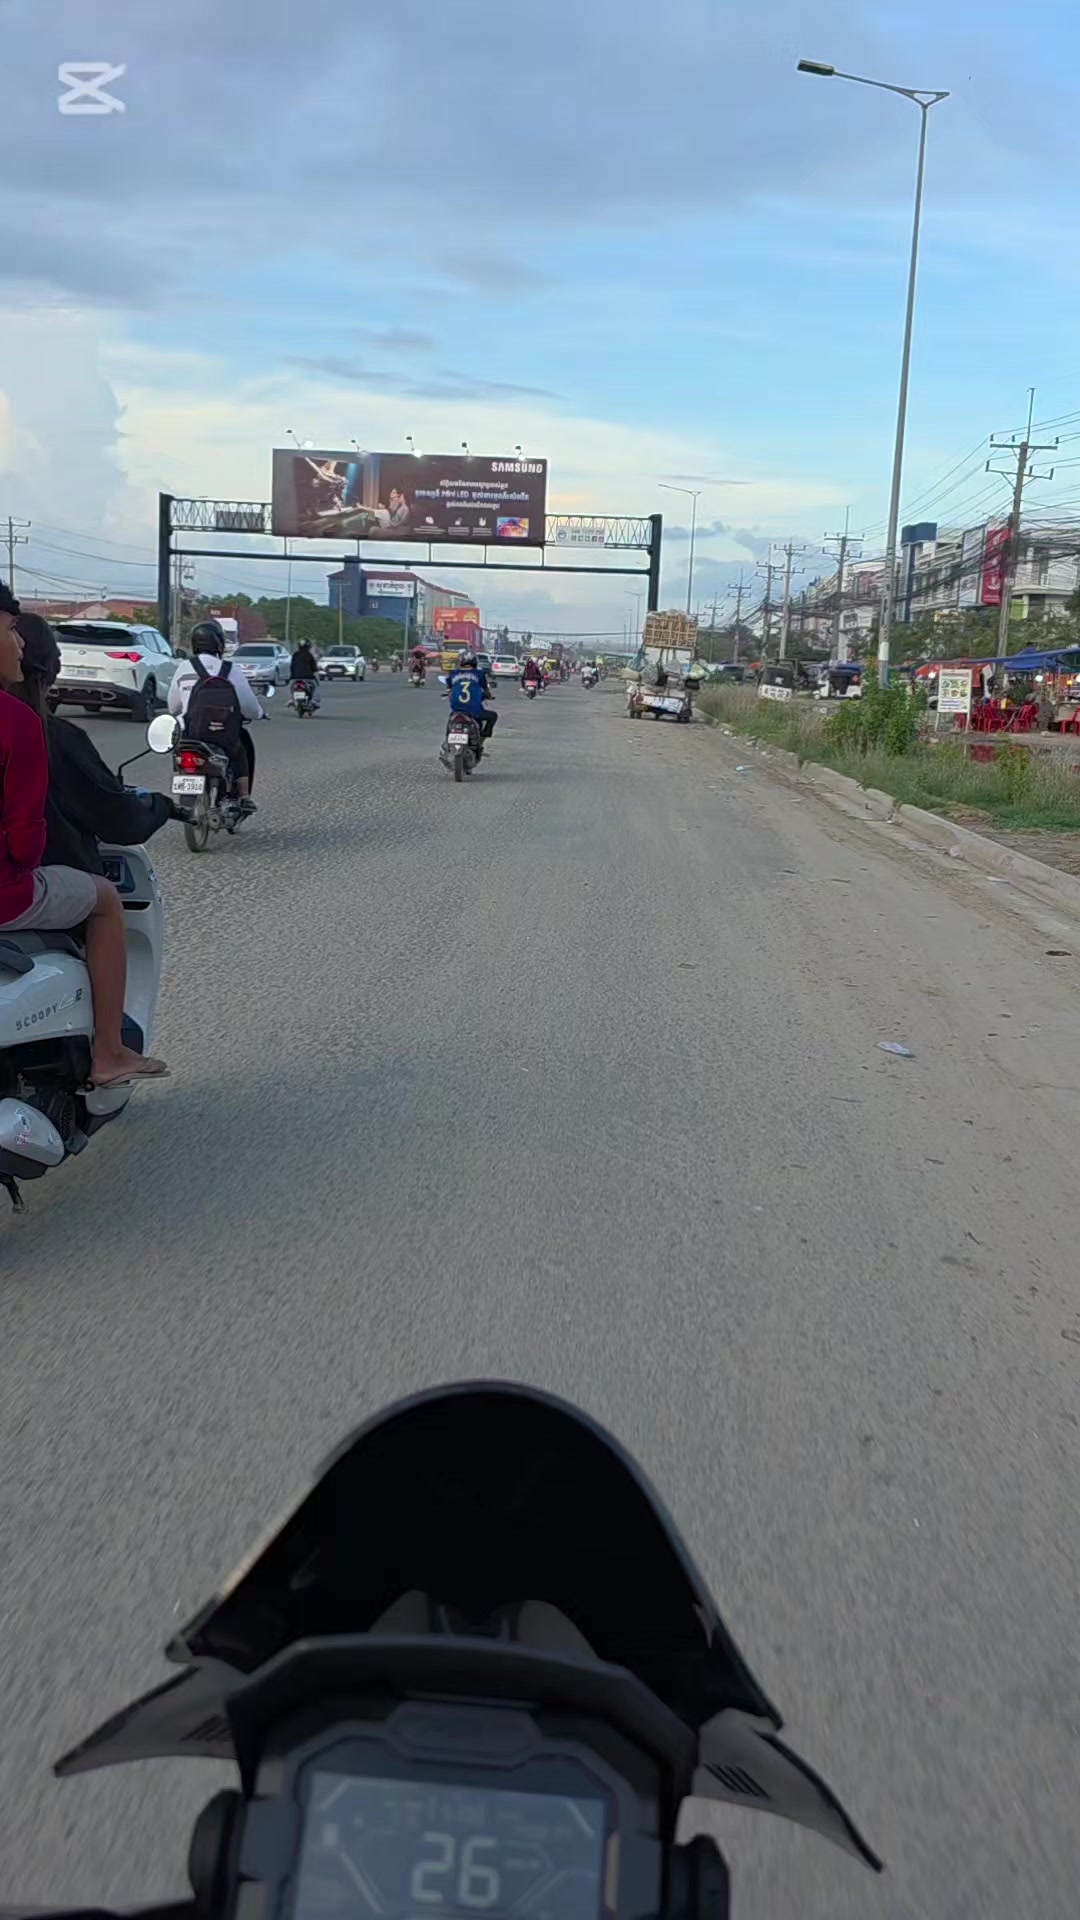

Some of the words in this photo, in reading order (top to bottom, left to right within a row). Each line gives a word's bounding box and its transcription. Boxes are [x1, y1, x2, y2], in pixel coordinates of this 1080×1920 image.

[491, 462, 543, 473] SAMSUNG
[458, 681, 471, 703] 3
[15, 1002, 58, 1032] SCOOPY
[411, 1830, 500, 1908] 26
